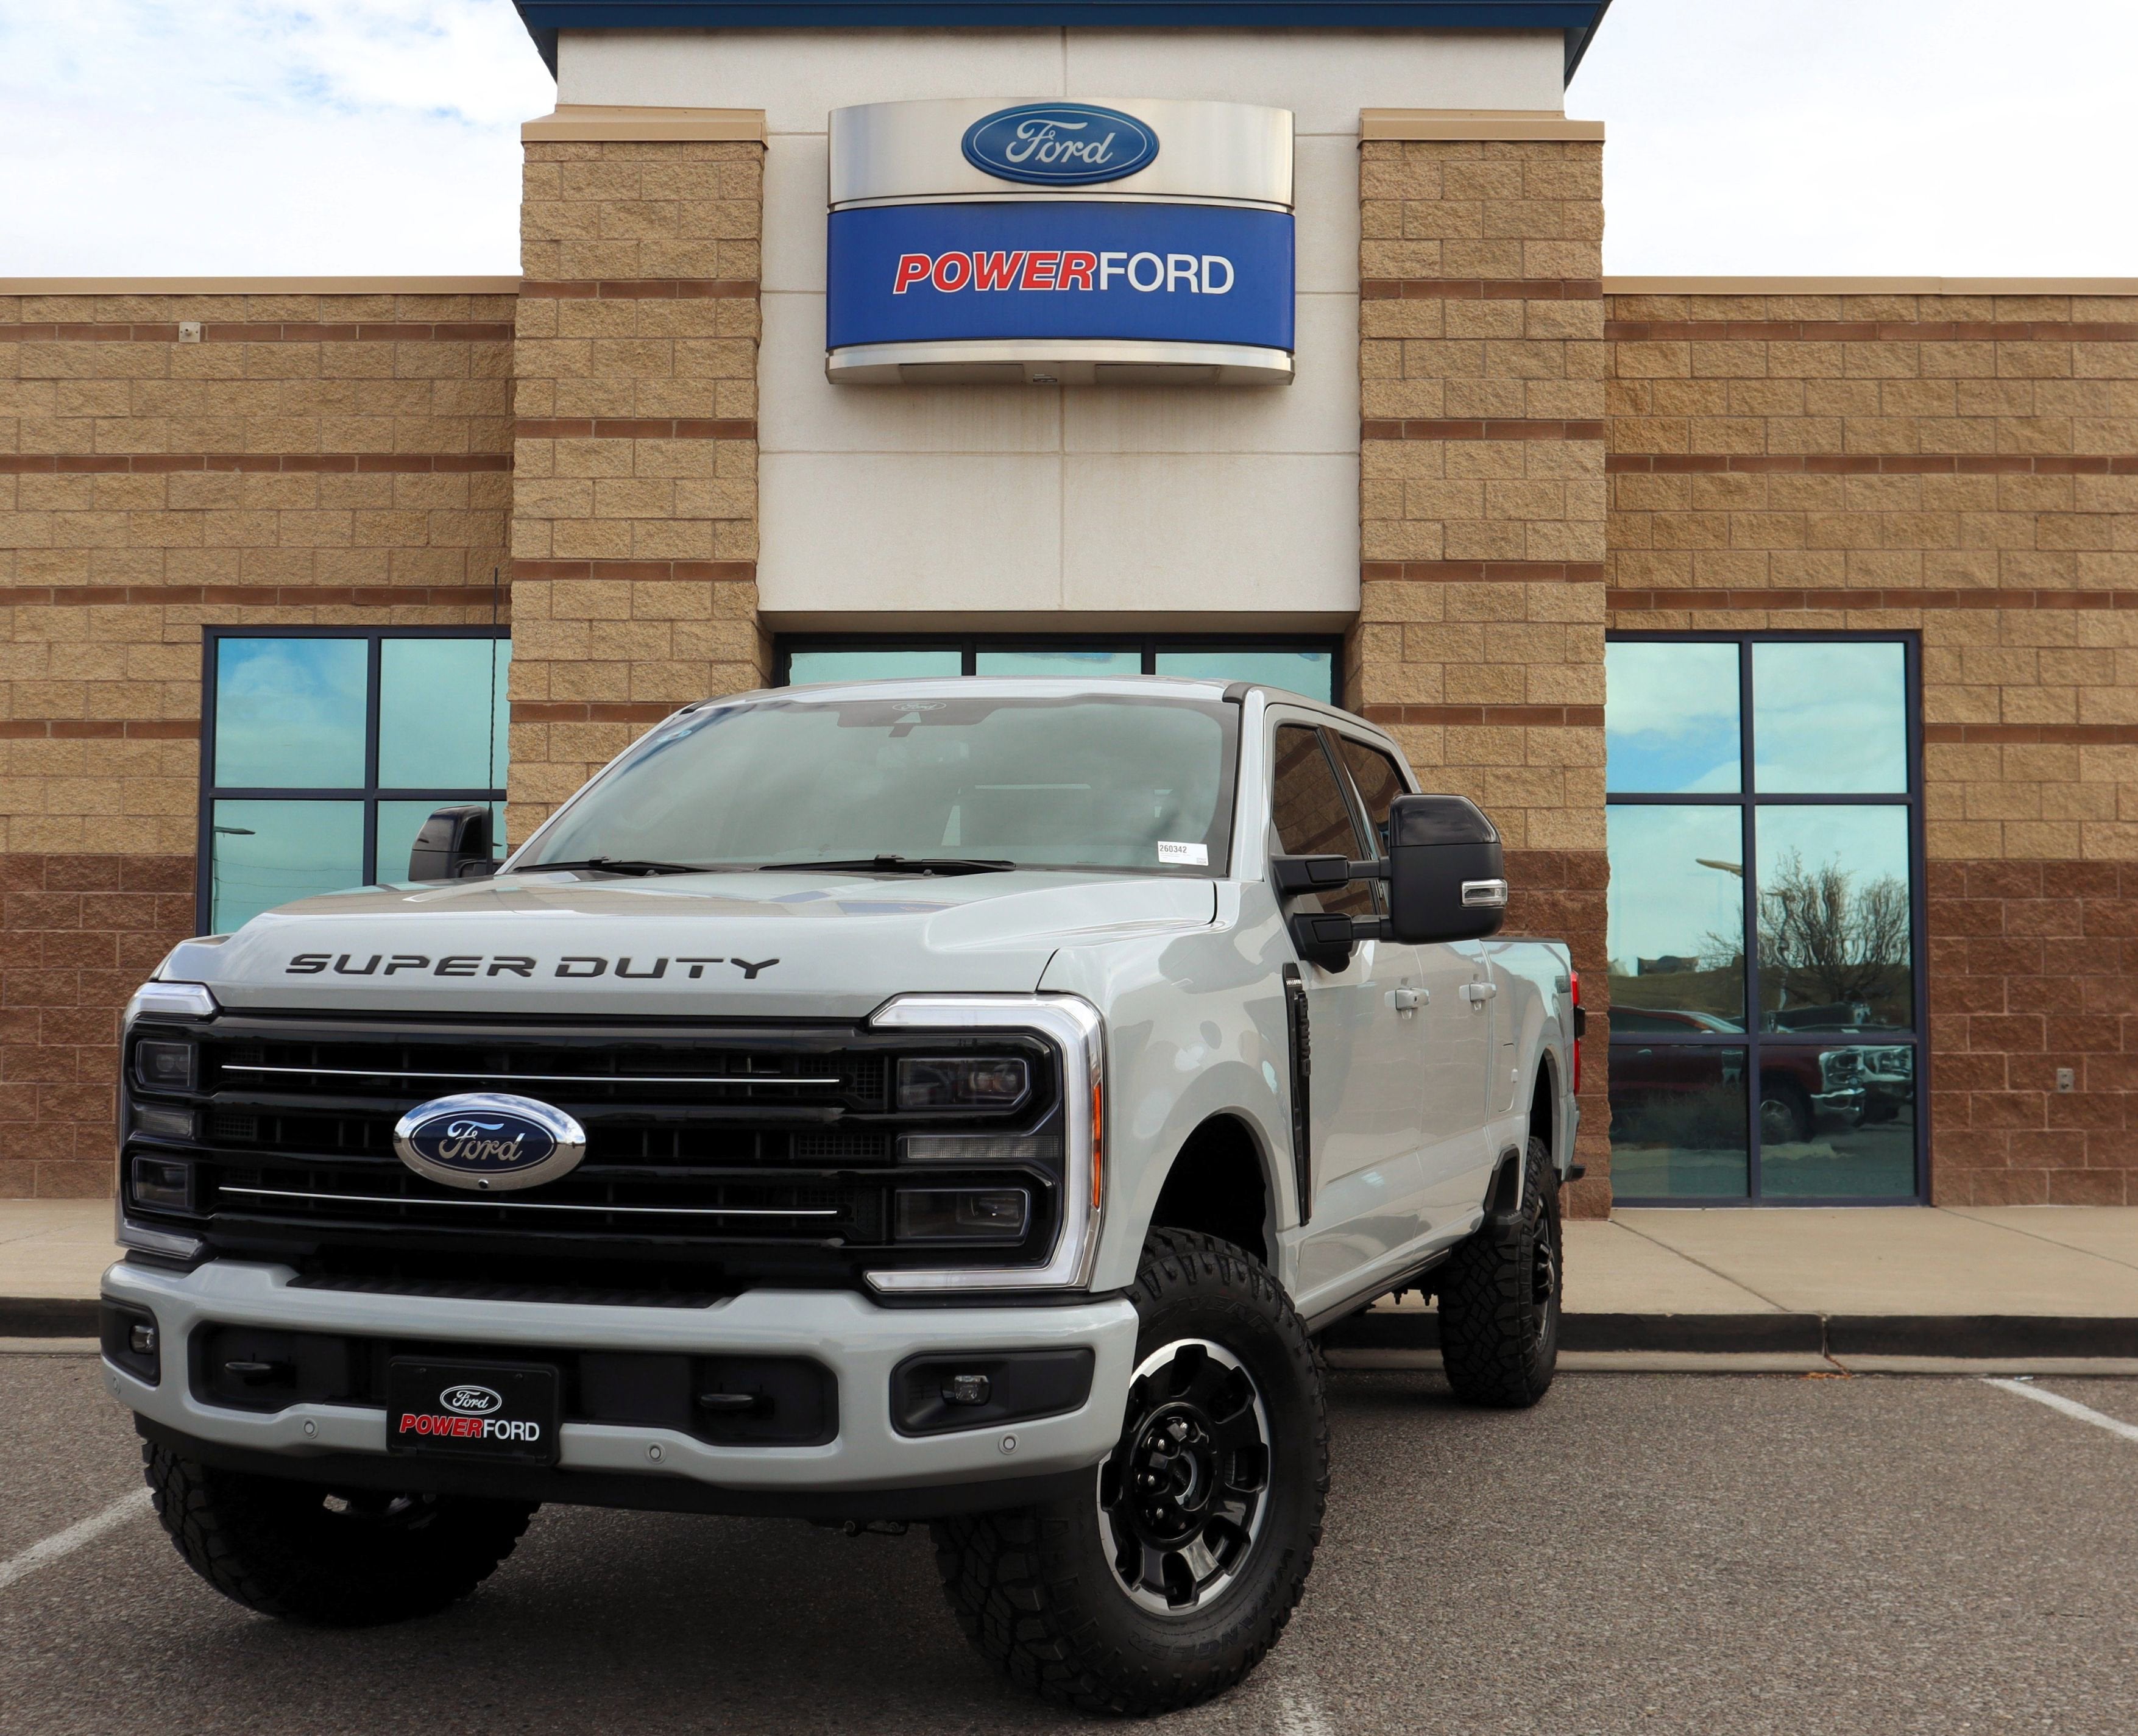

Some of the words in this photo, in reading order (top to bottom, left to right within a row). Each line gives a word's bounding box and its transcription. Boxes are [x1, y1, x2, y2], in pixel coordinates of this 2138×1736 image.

[1005, 119, 1115, 164] Ford
[1159, 845, 1188, 853] 260342
[285, 954, 537, 977] SUPER
[554, 957, 781, 979] DUTY
[438, 1120, 525, 1162] Ford
[453, 1390, 489, 1409] Ford
